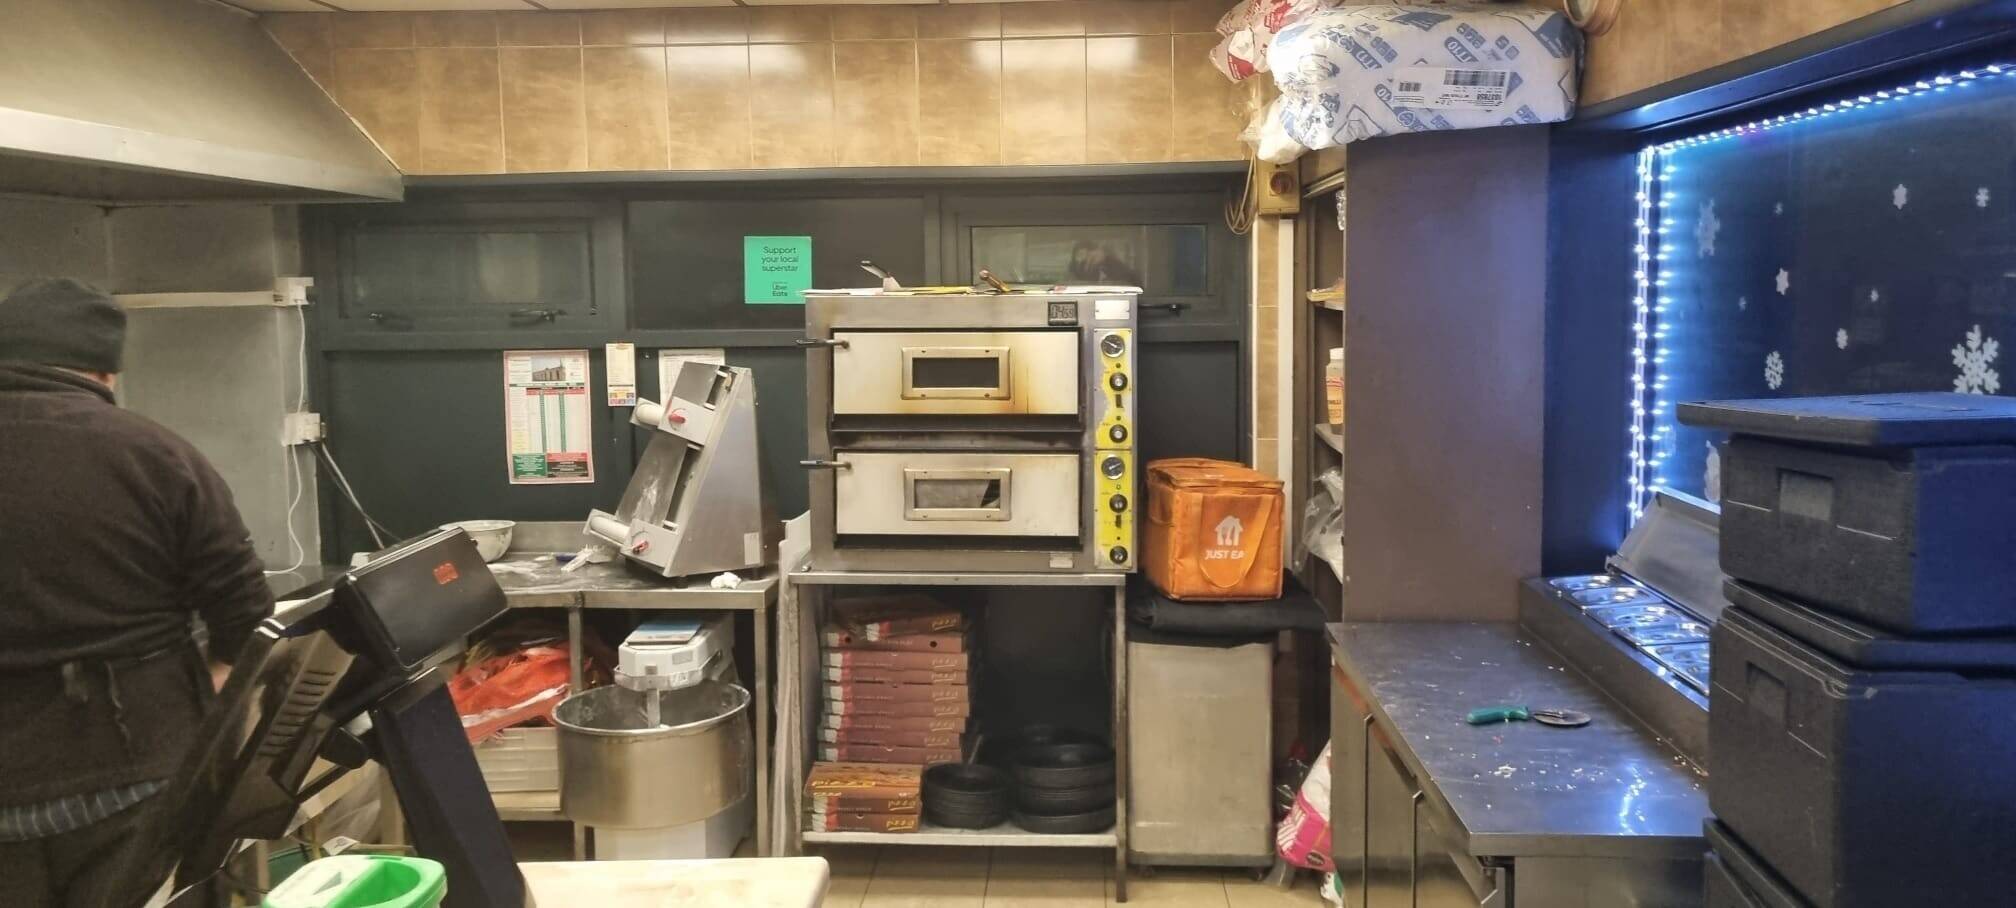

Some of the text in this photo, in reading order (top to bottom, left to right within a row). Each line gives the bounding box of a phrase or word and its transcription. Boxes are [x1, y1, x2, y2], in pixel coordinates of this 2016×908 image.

[763, 247, 796, 255] Support
[1205, 550, 1245, 560] JUST EA
